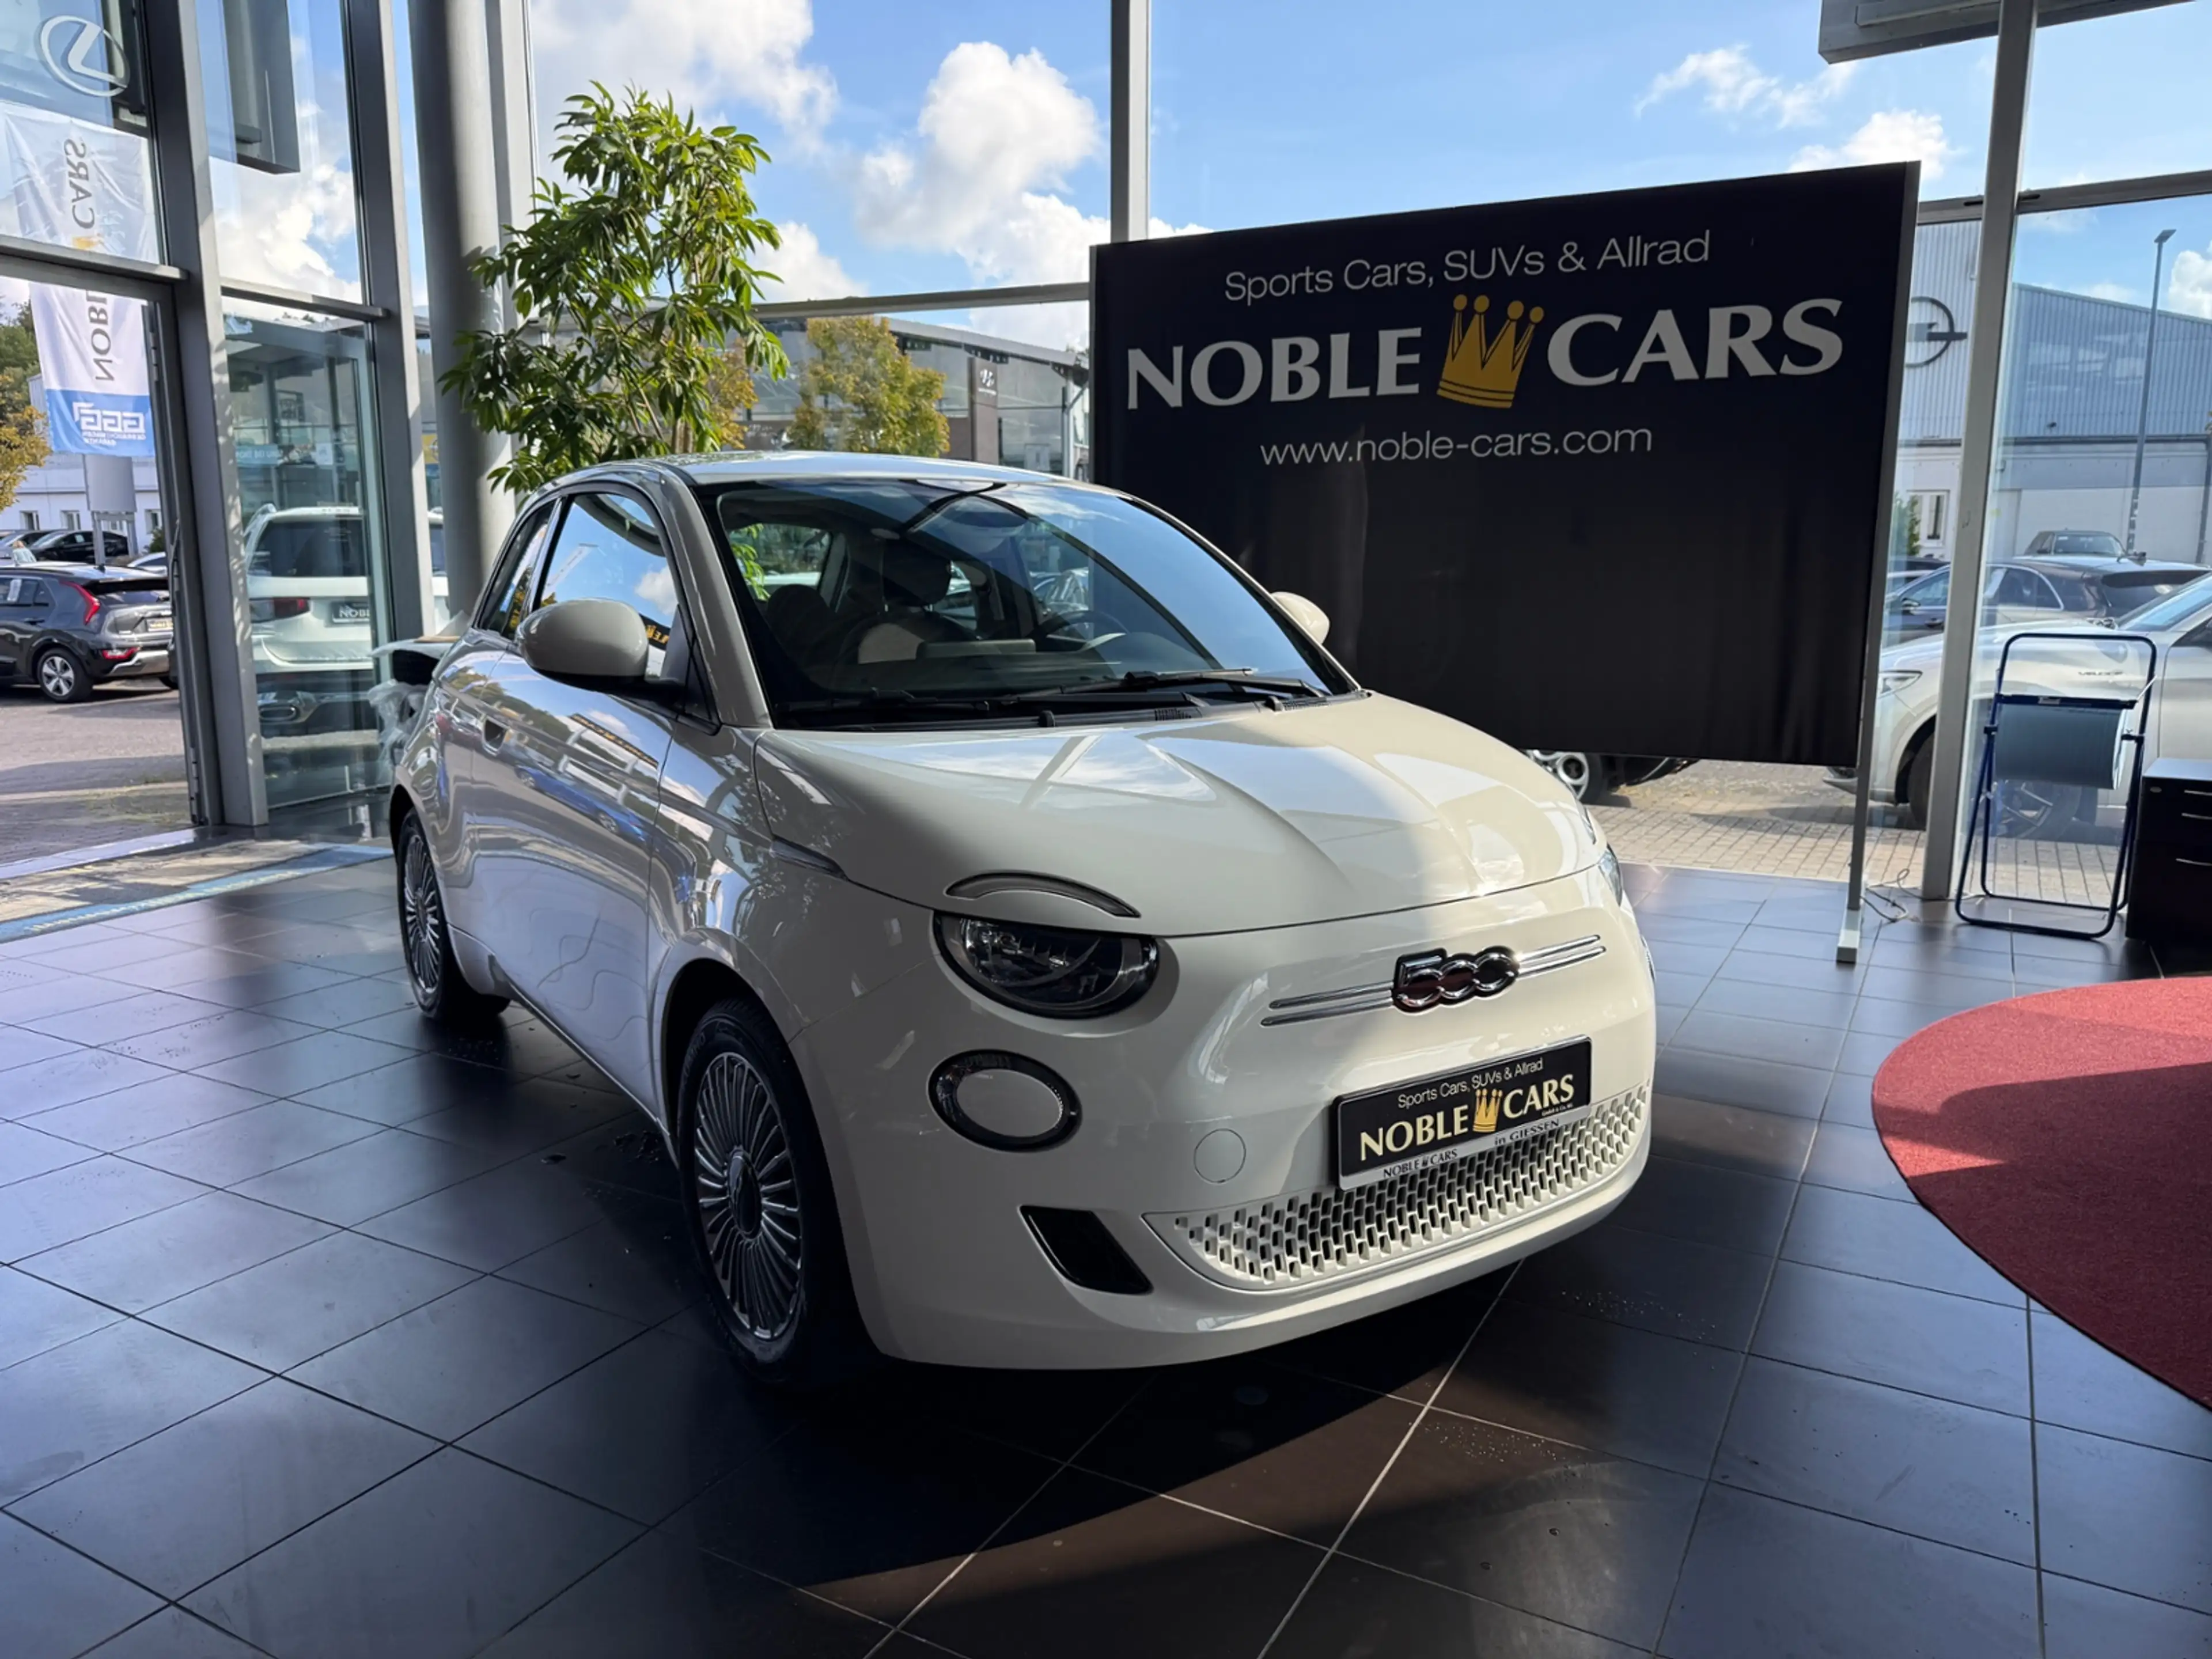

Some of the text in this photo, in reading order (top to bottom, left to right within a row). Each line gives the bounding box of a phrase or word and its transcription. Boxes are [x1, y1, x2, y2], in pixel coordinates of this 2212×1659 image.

[1225, 229, 1710, 306] Sports Cars, SUVs & Allrad
[1127, 298, 1843, 410] NOBLE CARS
[1259, 427, 1652, 465] www.noble-cars.com
[339, 608, 370, 618] NOBL
[1394, 948, 1519, 1010] 500
[1397, 1056, 1544, 1109] Sports Cars, SUVs & Allrad
[1360, 1073, 1575, 1162] NOBLE CARS
[1494, 1118, 1559, 1146] in GIESSEN
[1383, 1148, 1458, 1179] NOBLE CARS
